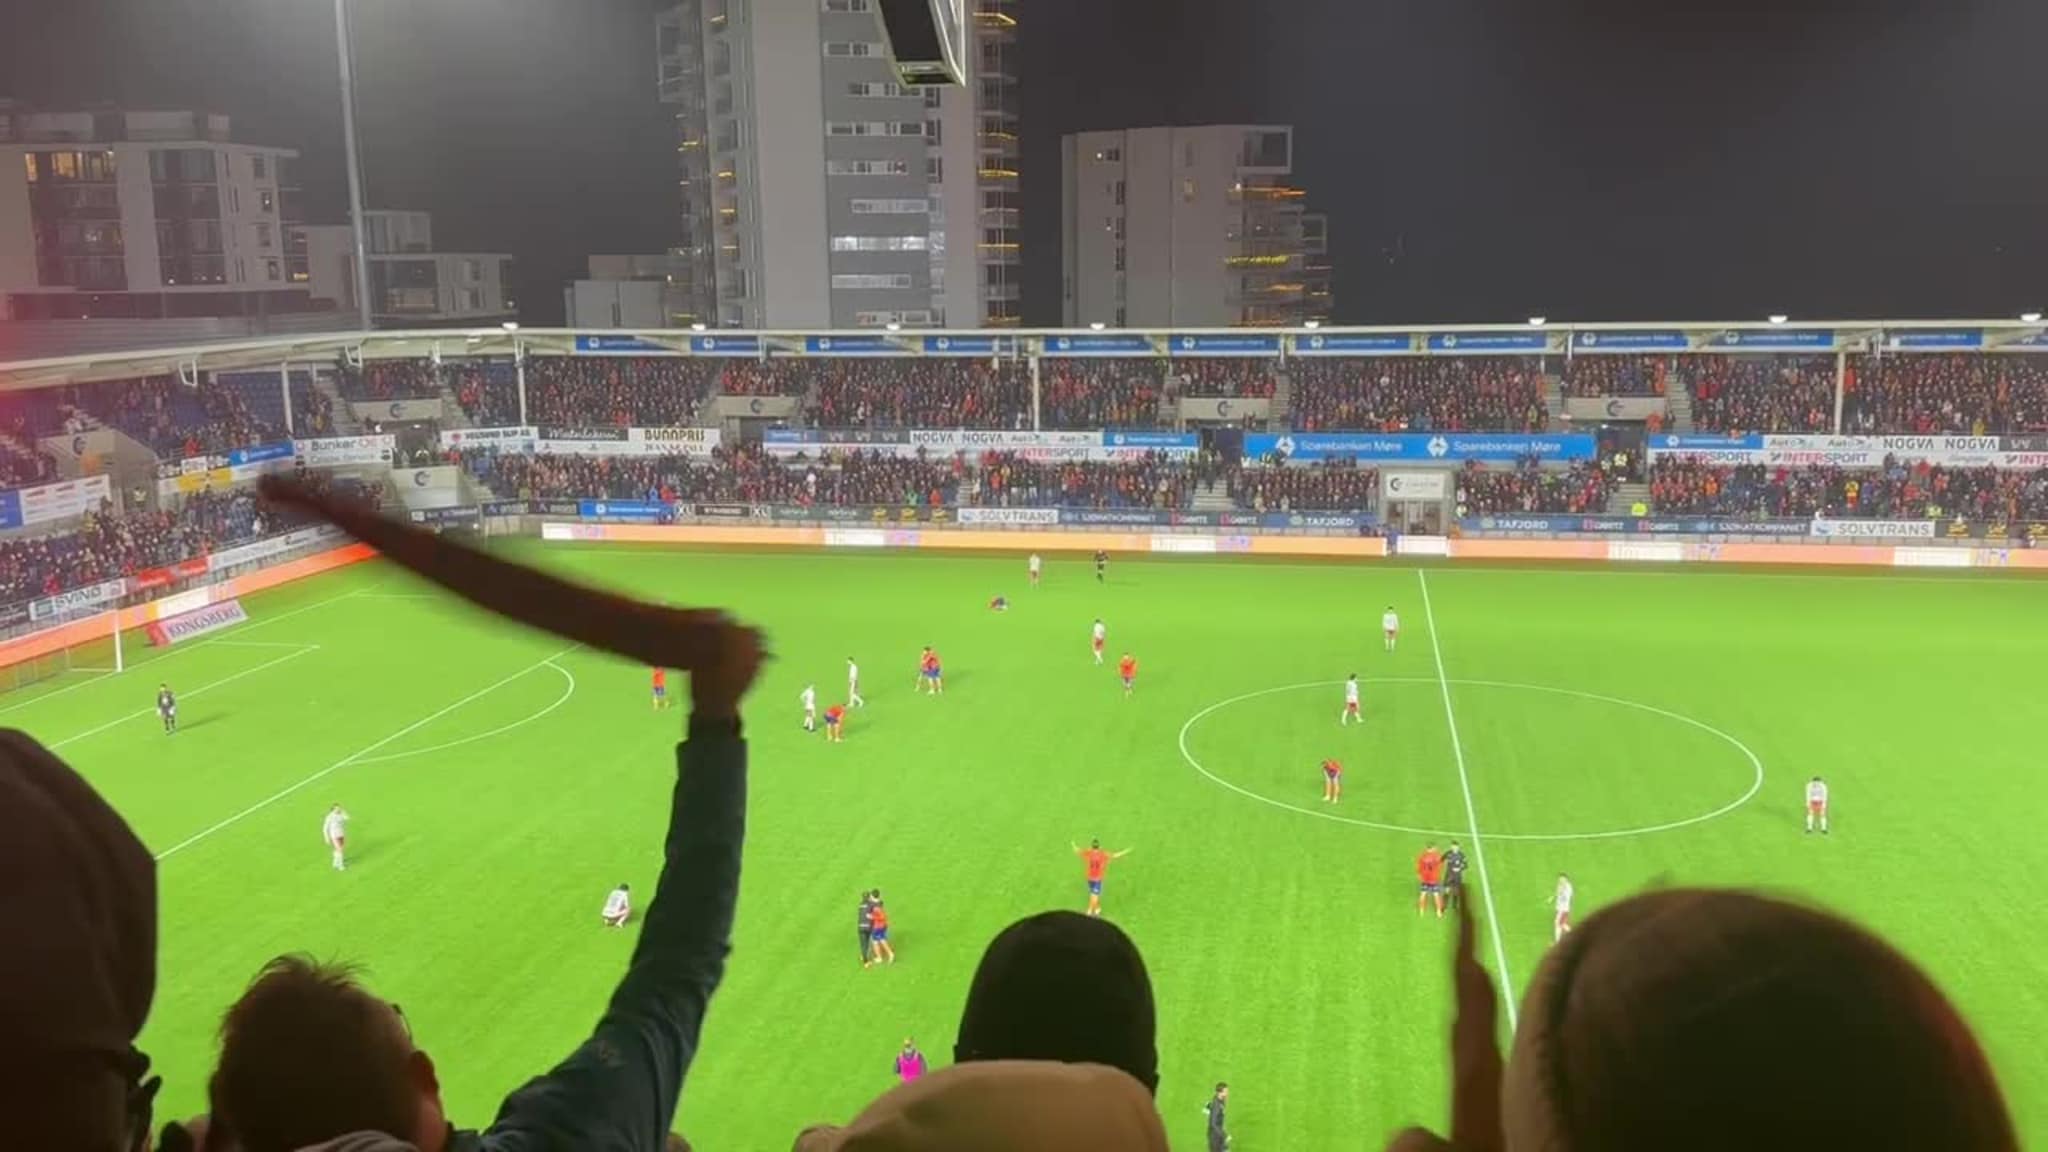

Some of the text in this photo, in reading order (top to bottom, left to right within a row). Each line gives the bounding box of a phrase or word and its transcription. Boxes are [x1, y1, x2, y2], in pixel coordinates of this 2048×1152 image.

[913, 432, 953, 443] NOGVA
[962, 433, 1003, 443] NOGVA
[311, 439, 357, 452] Bunker
[1301, 440, 1371, 452] Sparebanken
[1883, 438, 1935, 450] NOGVA
[1945, 438, 1997, 450] NOGVA
[1784, 452, 1868, 463] INTERSPORT
[980, 510, 1056, 521] SOLVTRANS
[1306, 518, 1354, 527] TAFJORD
[1497, 520, 1548, 530] TAFJORD
[1838, 523, 1930, 535] SOLVTRANS
[168, 607, 240, 637] KONGSBERG
